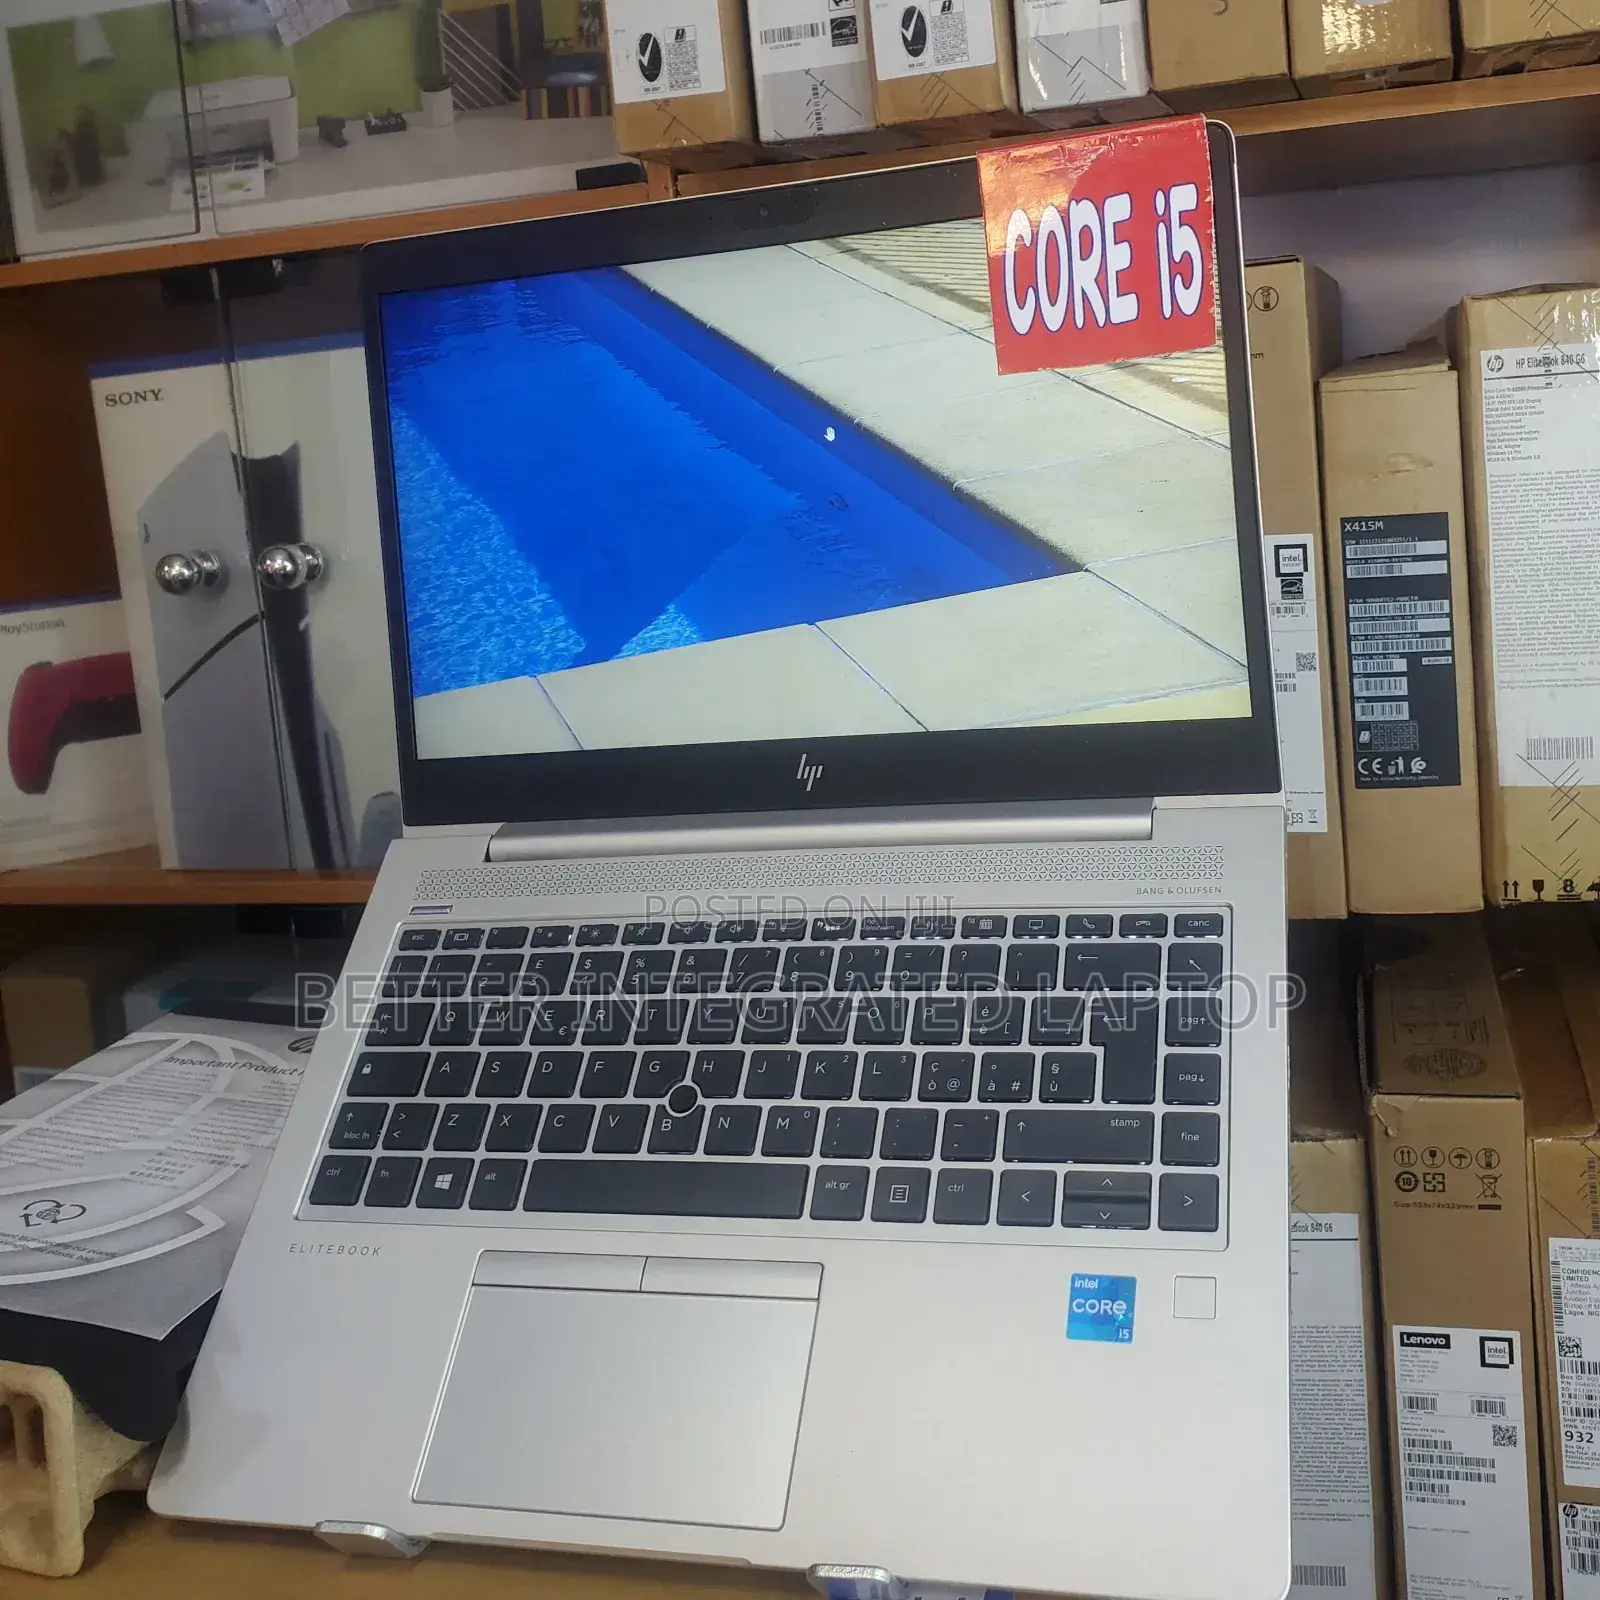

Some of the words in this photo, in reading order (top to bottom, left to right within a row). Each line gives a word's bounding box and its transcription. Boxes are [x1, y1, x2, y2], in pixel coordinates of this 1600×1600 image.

[1003, 192, 1139, 335] CORE
[1155, 182, 1204, 320] i5
[1516, 358, 1525, 369] HP
[1576, 353, 1586, 364] G6
[104, 388, 164, 408] SONY
[1344, 520, 1384, 532] X415M
[1136, 887, 1164, 895] BANG
[1167, 886, 1174, 895] &
[1176, 886, 1222, 895] OLUFSEN
[1187, 919, 1210, 927] canc
[411, 934, 425, 942] esc
[765, 950, 771, 958] 7
[819, 949, 825, 957] 8
[874, 948, 880, 956] 9
[960, 950, 968, 960] ?
[534, 959, 544, 969] £
[583, 958, 592, 970] $
[635, 958, 646, 968] %
[686, 956, 696, 966] &
[630, 975, 640, 984] 5
[683, 973, 693, 983] 6
[736, 972, 745, 983] 7
[790, 971, 799, 982] 8
[845, 970, 854, 981] 9
[478, 977, 488, 987] 2
[445, 1011, 456, 1022] Q
[496, 1010, 511, 1021] W
[544, 1009, 555, 1021] E
[595, 1009, 606, 1020] R
[648, 1008, 658, 1020] T
[703, 1008, 714, 1019] Y
[756, 1007, 767, 1019] U
[868, 1007, 880, 1019] O
[923, 1007, 934, 1019] P
[981, 1006, 990, 1016] é
[1180, 1016, 1198, 1025] pag
[558, 1025, 568, 1035] €
[979, 1023, 987, 1034] è
[842, 1055, 849, 1063] 2
[164, 1055, 240, 1069] Important
[240, 1060, 300, 1077] Product
[440, 1061, 451, 1073] A
[490, 1061, 501, 1073] S
[541, 1061, 554, 1073] D
[593, 1061, 605, 1073] F
[649, 1061, 661, 1073] G
[702, 1060, 714, 1072] H
[757, 1061, 767, 1073] J
[814, 1061, 827, 1074] K
[872, 1062, 882, 1074] L
[1051, 1062, 1060, 1074] §
[1178, 1073, 1198, 1082] pag
[946, 1077, 961, 1091] @
[987, 1080, 996, 1091] à
[1010, 1080, 1022, 1091] #
[1050, 1080, 1058, 1091] ù
[447, 1114, 459, 1126] Z
[499, 1114, 512, 1127] X
[553, 1115, 565, 1127] C
[608, 1114, 621, 1128] V
[660, 1118, 672, 1131] B
[718, 1116, 731, 1129] N
[776, 1117, 790, 1130] M
[1110, 1117, 1140, 1129] stamp
[343, 1130, 359, 1140] bloc
[360, 1130, 370, 1140] fn
[1180, 1132, 1200, 1141] fine
[326, 1168, 340, 1177] ctrl
[380, 1169, 389, 1178] fn
[484, 1172, 497, 1181] alt
[824, 1180, 837, 1190] alt
[839, 1182, 850, 1192] gr
[1401, 1177, 1413, 1187] 10
[948, 1183, 965, 1193] ctrl
[1311, 1222, 1323, 1233] 840
[1324, 1222, 1334, 1233] G6
[289, 1243, 383, 1258] ELITEBOOK
[1074, 1277, 1099, 1289] intel
[1564, 1309, 1584, 1317] Lagos
[1403, 1334, 1446, 1345] Lenovo
[1565, 1431, 1595, 1444] 932
[1565, 1504, 1577, 1518] hp
